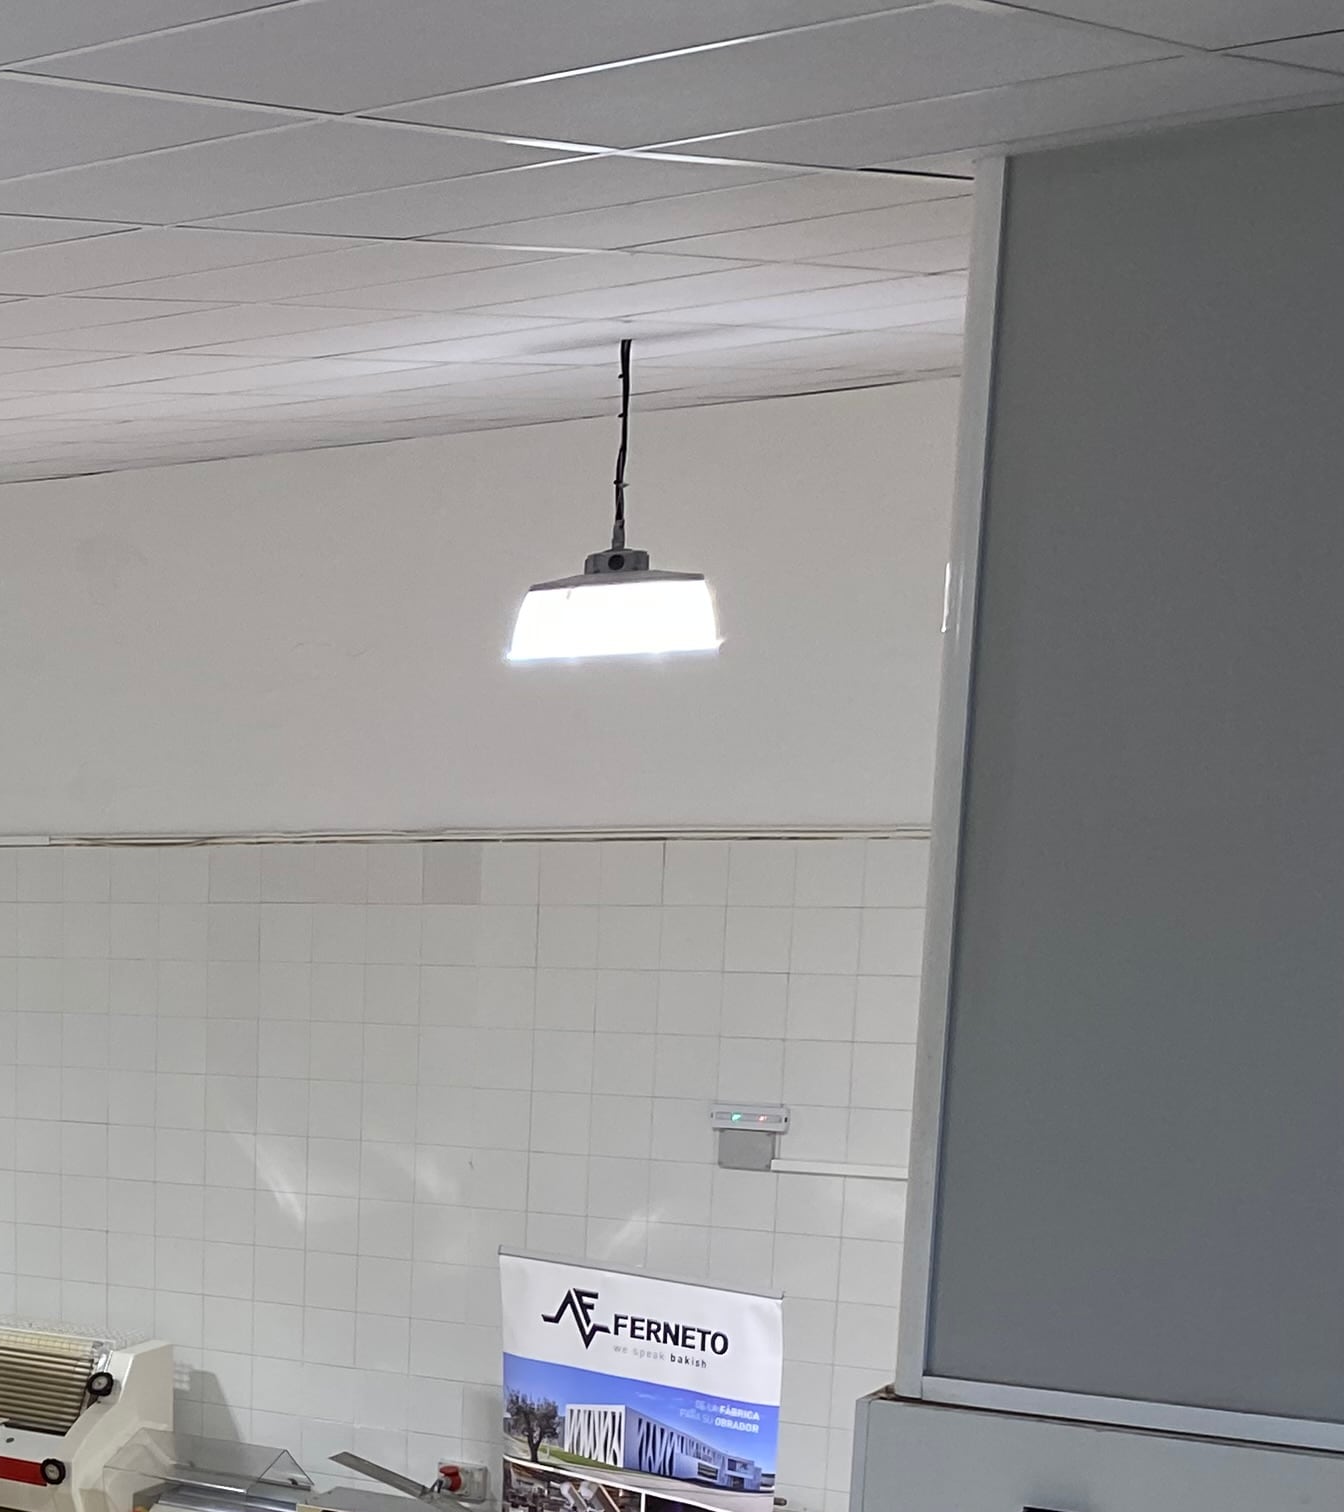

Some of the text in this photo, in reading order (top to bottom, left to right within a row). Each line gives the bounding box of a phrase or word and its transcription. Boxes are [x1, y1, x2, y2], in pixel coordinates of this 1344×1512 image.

[613, 1313, 729, 1356] FERNETO
[614, 1345, 707, 1368] we speak bakish
[719, 1404, 760, 1421] FÁBRICA
[714, 1417, 760, 1433] OBRADOR
